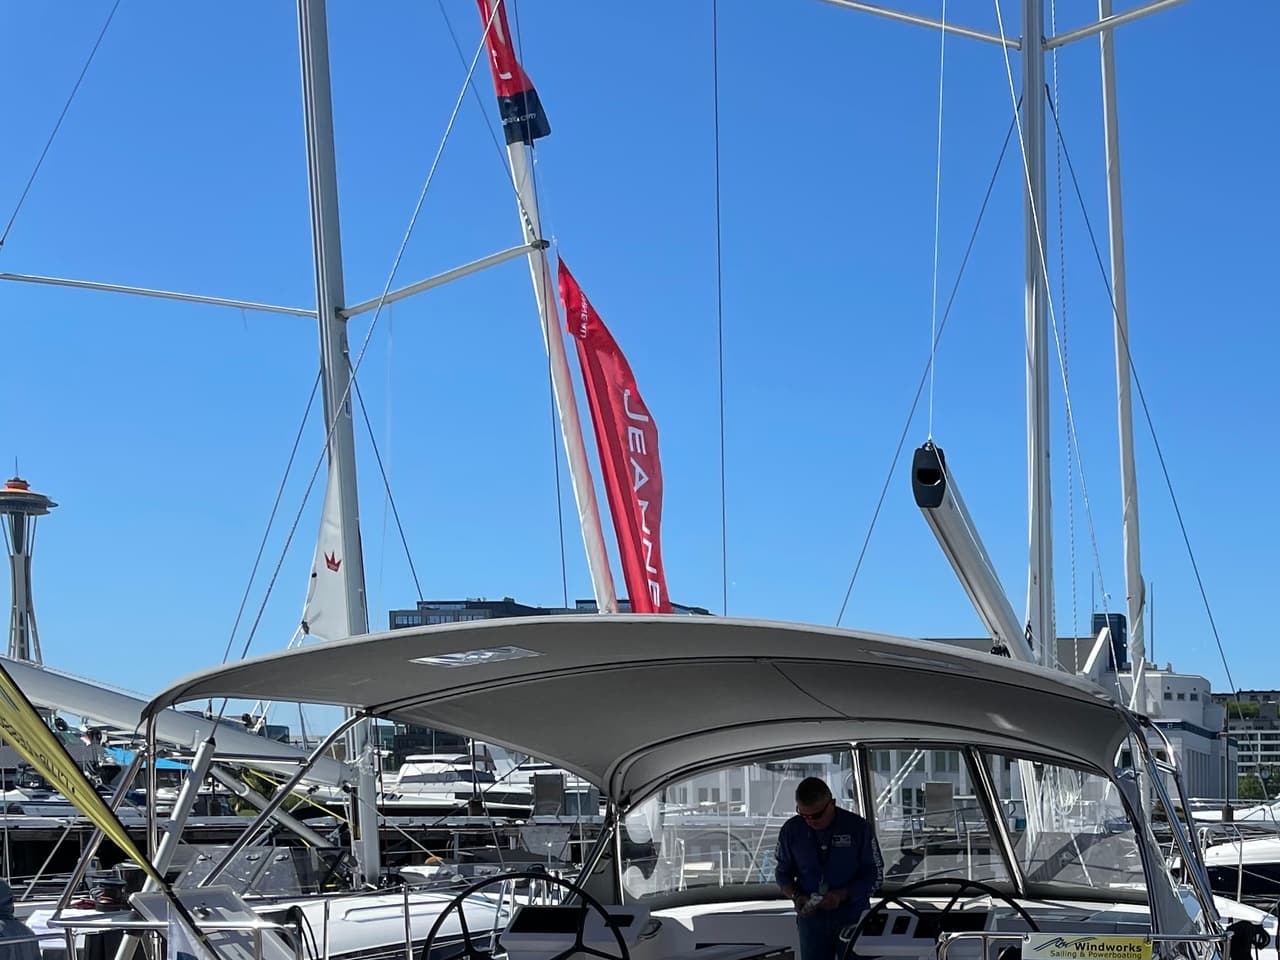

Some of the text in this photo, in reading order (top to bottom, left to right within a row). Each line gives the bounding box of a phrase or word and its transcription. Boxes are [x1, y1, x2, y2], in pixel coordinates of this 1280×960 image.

[1074, 942, 1142, 953] Windworks
[1050, 950, 1077, 959] Sailing
[1088, 951, 1142, 960] Powerboating
